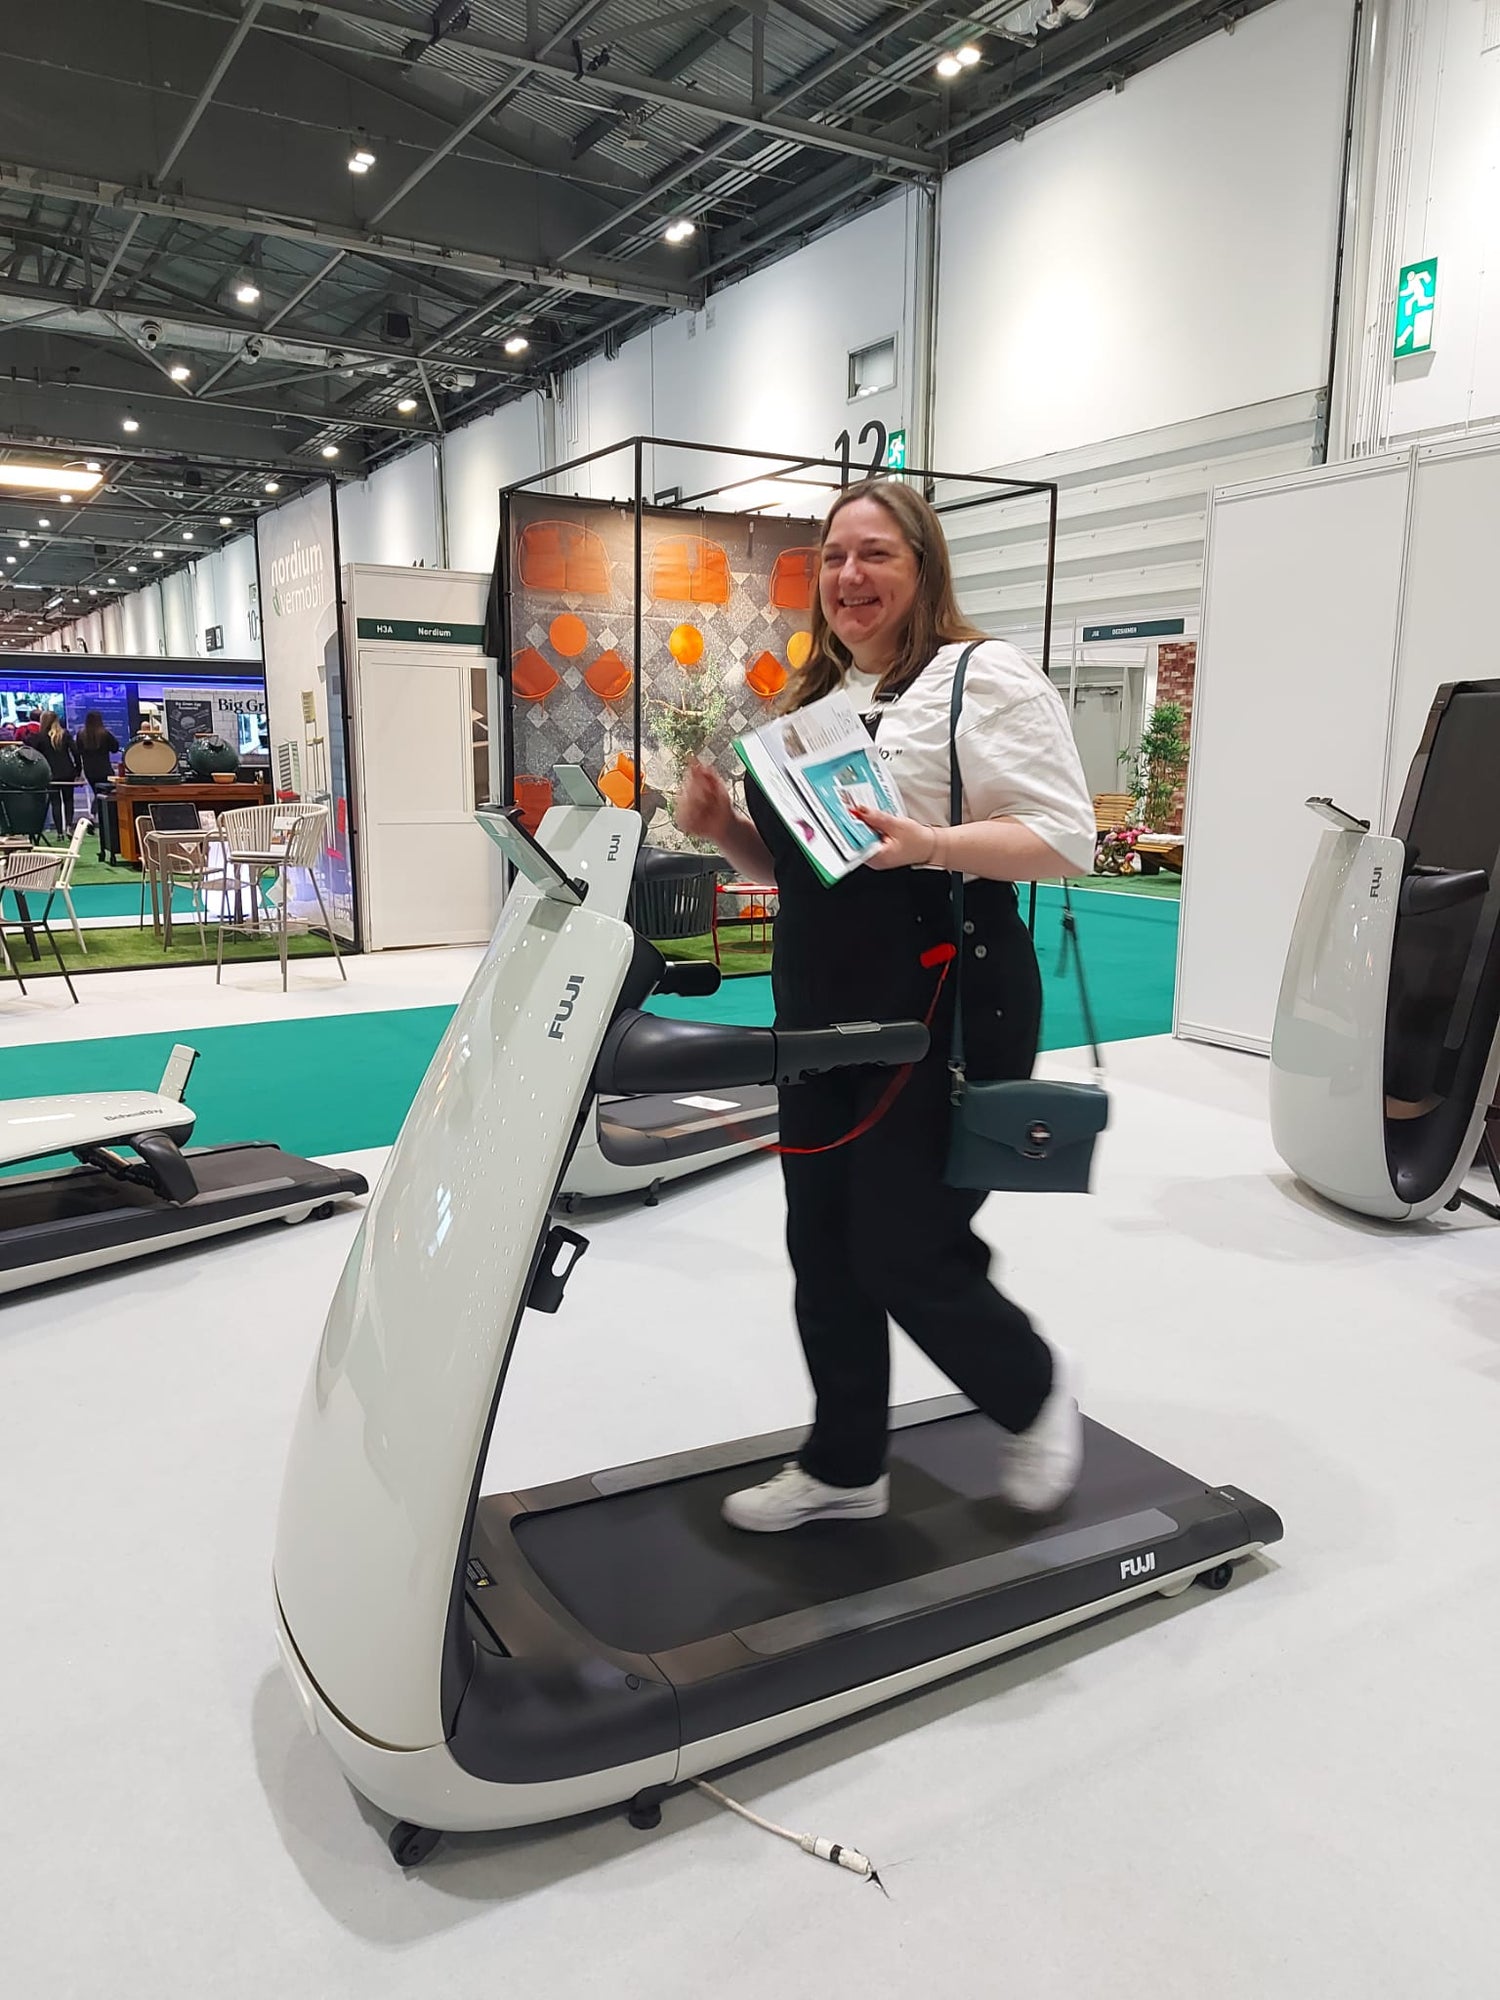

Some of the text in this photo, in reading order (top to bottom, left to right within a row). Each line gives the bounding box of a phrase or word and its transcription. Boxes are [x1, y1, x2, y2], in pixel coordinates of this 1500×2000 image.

[834, 419, 887, 489] 12
[271, 539, 323, 587] nordium
[376, 625, 452, 637] H3A Nordium
[218, 698, 244, 714] Big
[246, 699, 265, 713] Gr
[607, 834, 622, 862] FUJI
[1370, 867, 1382, 897] FUJI
[547, 974, 585, 1040] FUJI
[1120, 1551, 1156, 1580] FUJI
